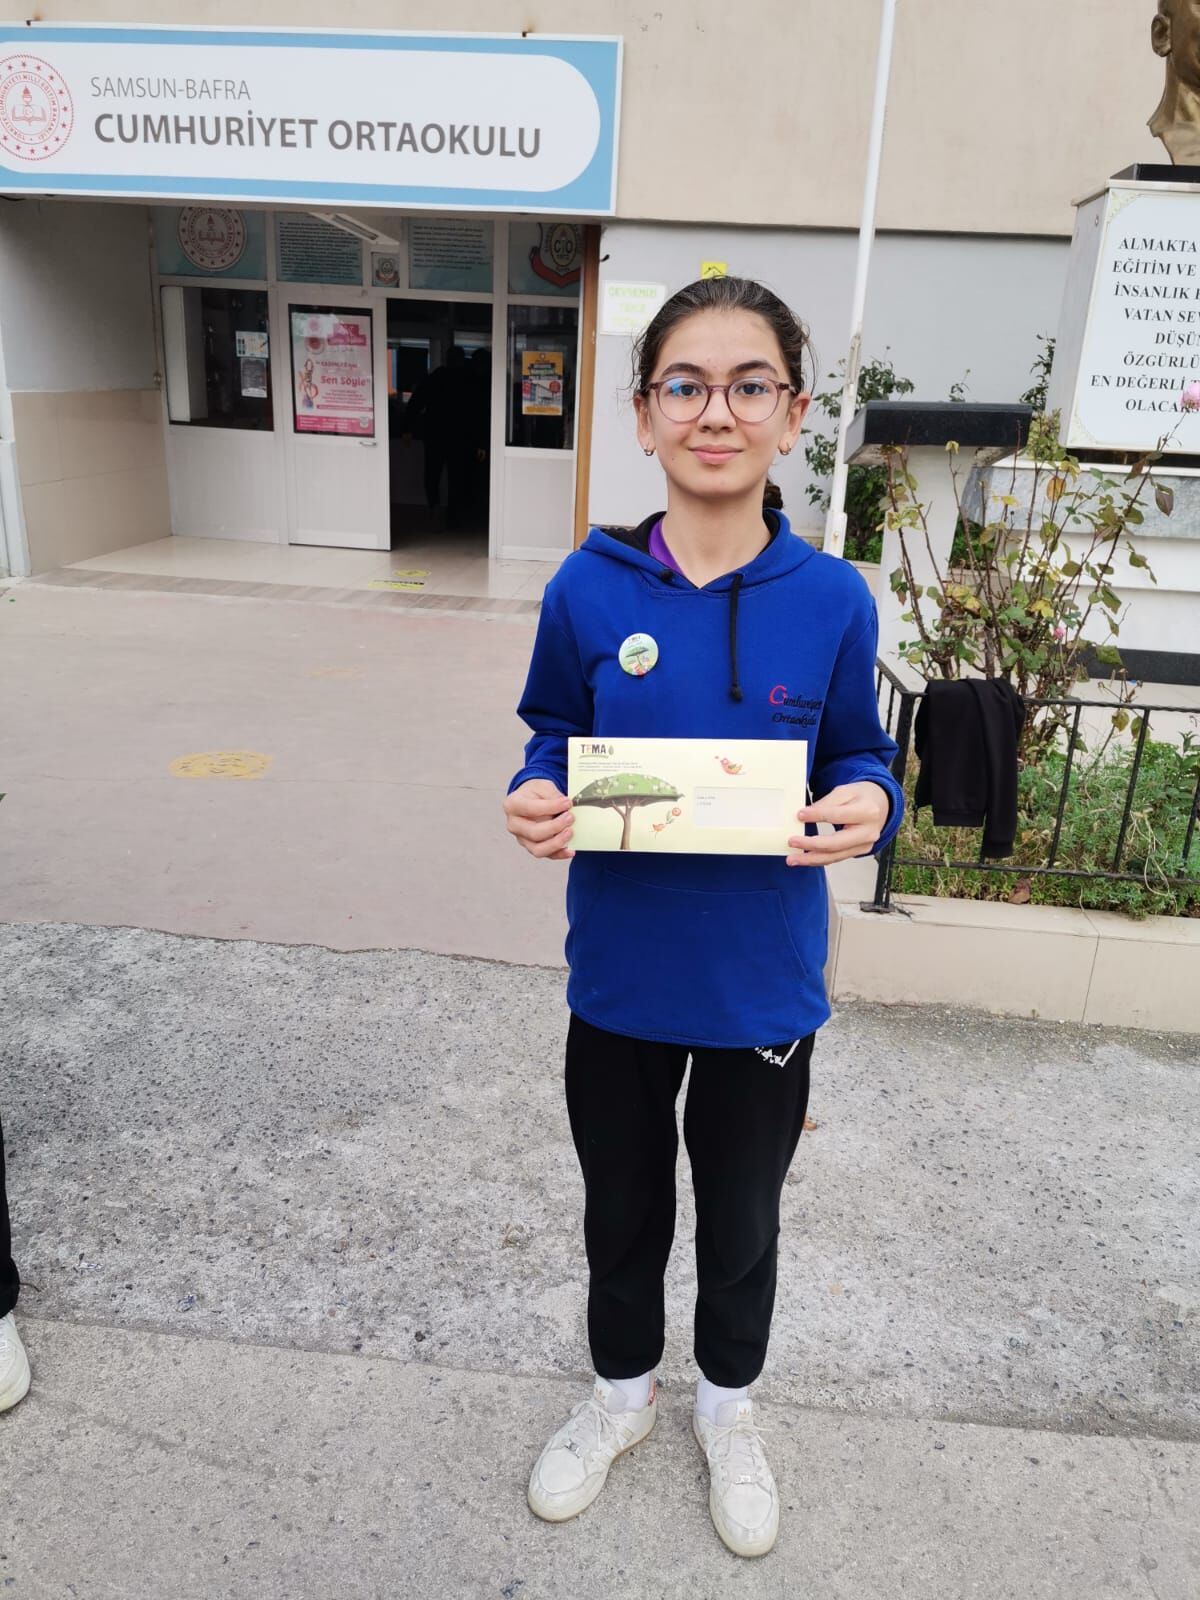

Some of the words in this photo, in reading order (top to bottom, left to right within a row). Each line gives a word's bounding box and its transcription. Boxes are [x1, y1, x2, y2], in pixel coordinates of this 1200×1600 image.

[90, 76, 251, 101] SAMSUN-BAFRA
[94, 110, 318, 149] CUMHURİYET
[327, 119, 541, 158] ORTAOKULU
[1118, 237, 1197, 252] ALMAKTA
[1112, 258, 1171, 275] EĞİTİM
[1176, 263, 1197, 276] VE
[1114, 281, 1191, 299] İNSANLIK
[1125, 307, 1174, 321] VATAN
[1177, 310, 1200, 323] SE
[1123, 351, 1200, 368] ÖZGÜRLÜ
[1091, 375, 1112, 387] EN
[1116, 374, 1185, 390] DEĞERLİ
